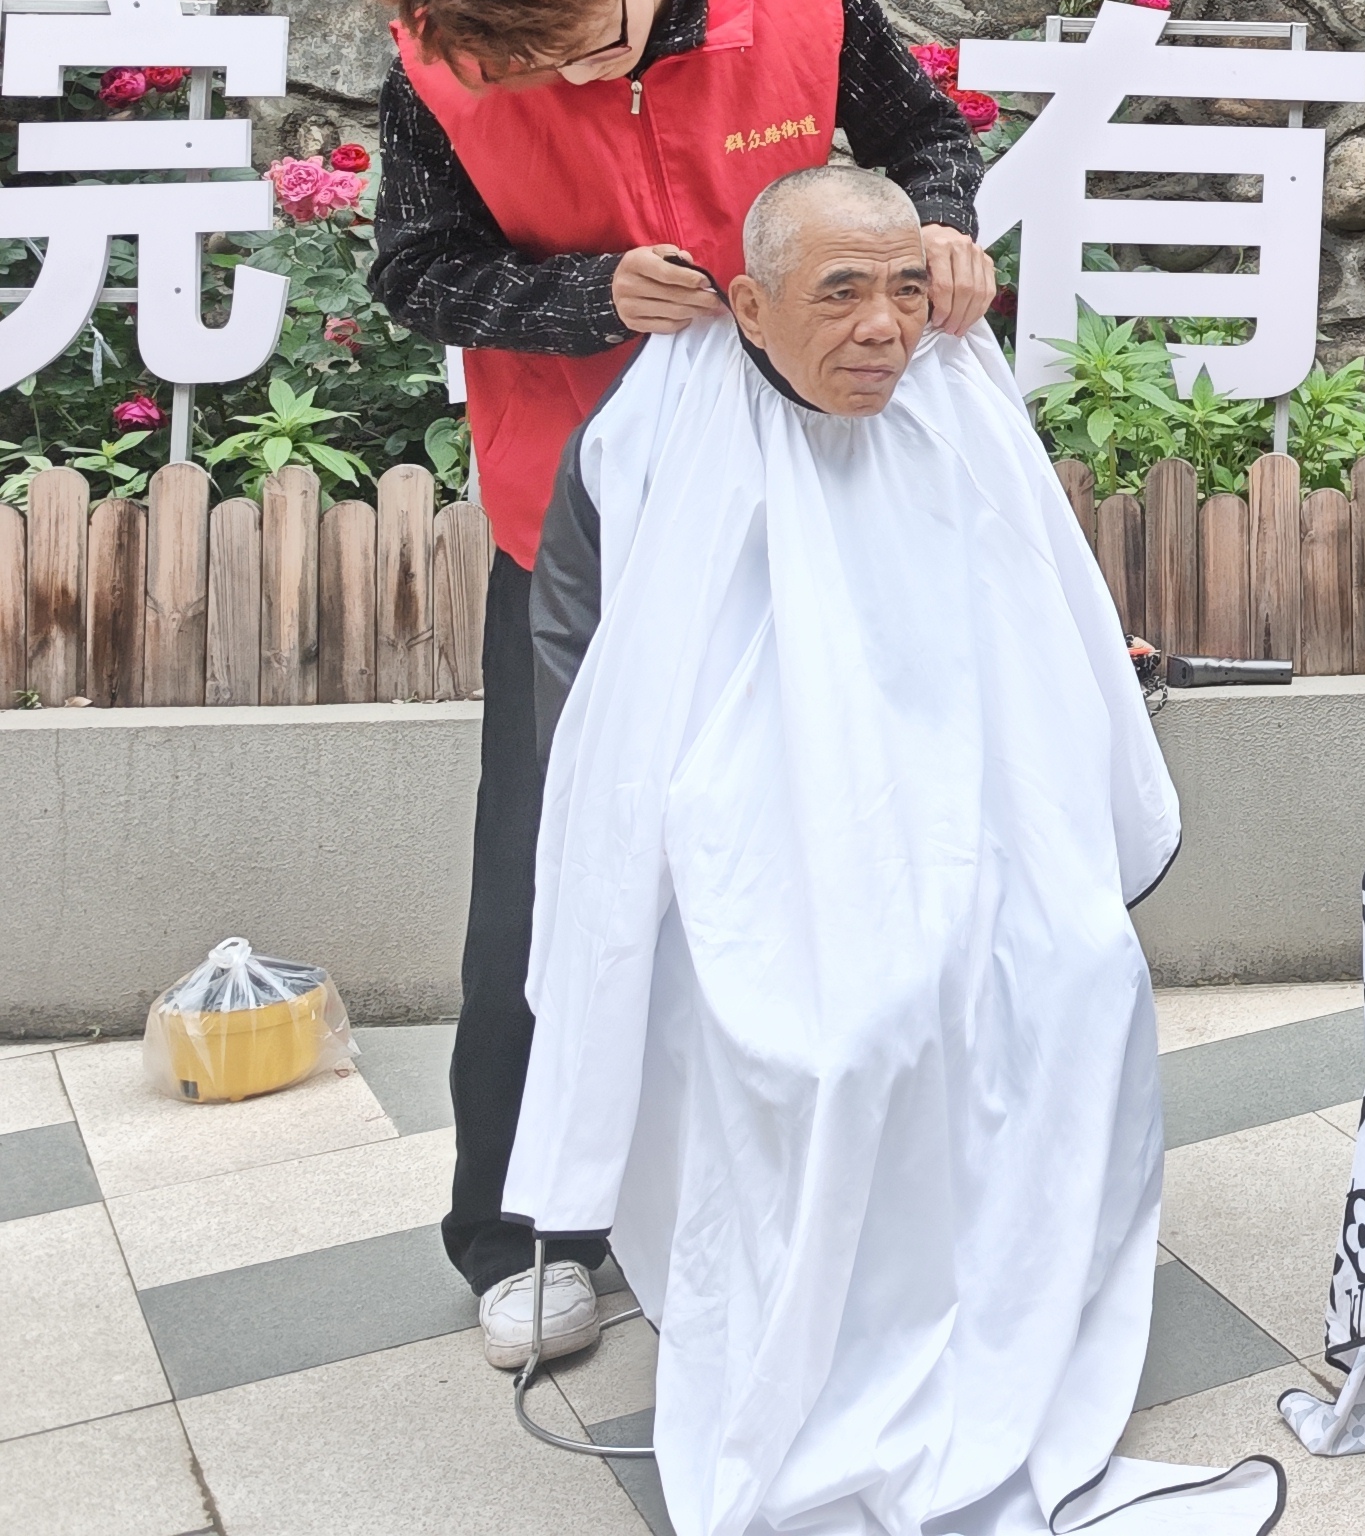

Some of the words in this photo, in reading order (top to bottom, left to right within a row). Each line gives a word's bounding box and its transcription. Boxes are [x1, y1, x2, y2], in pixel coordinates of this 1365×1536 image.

[723, 113, 822, 156] 群众路街道
